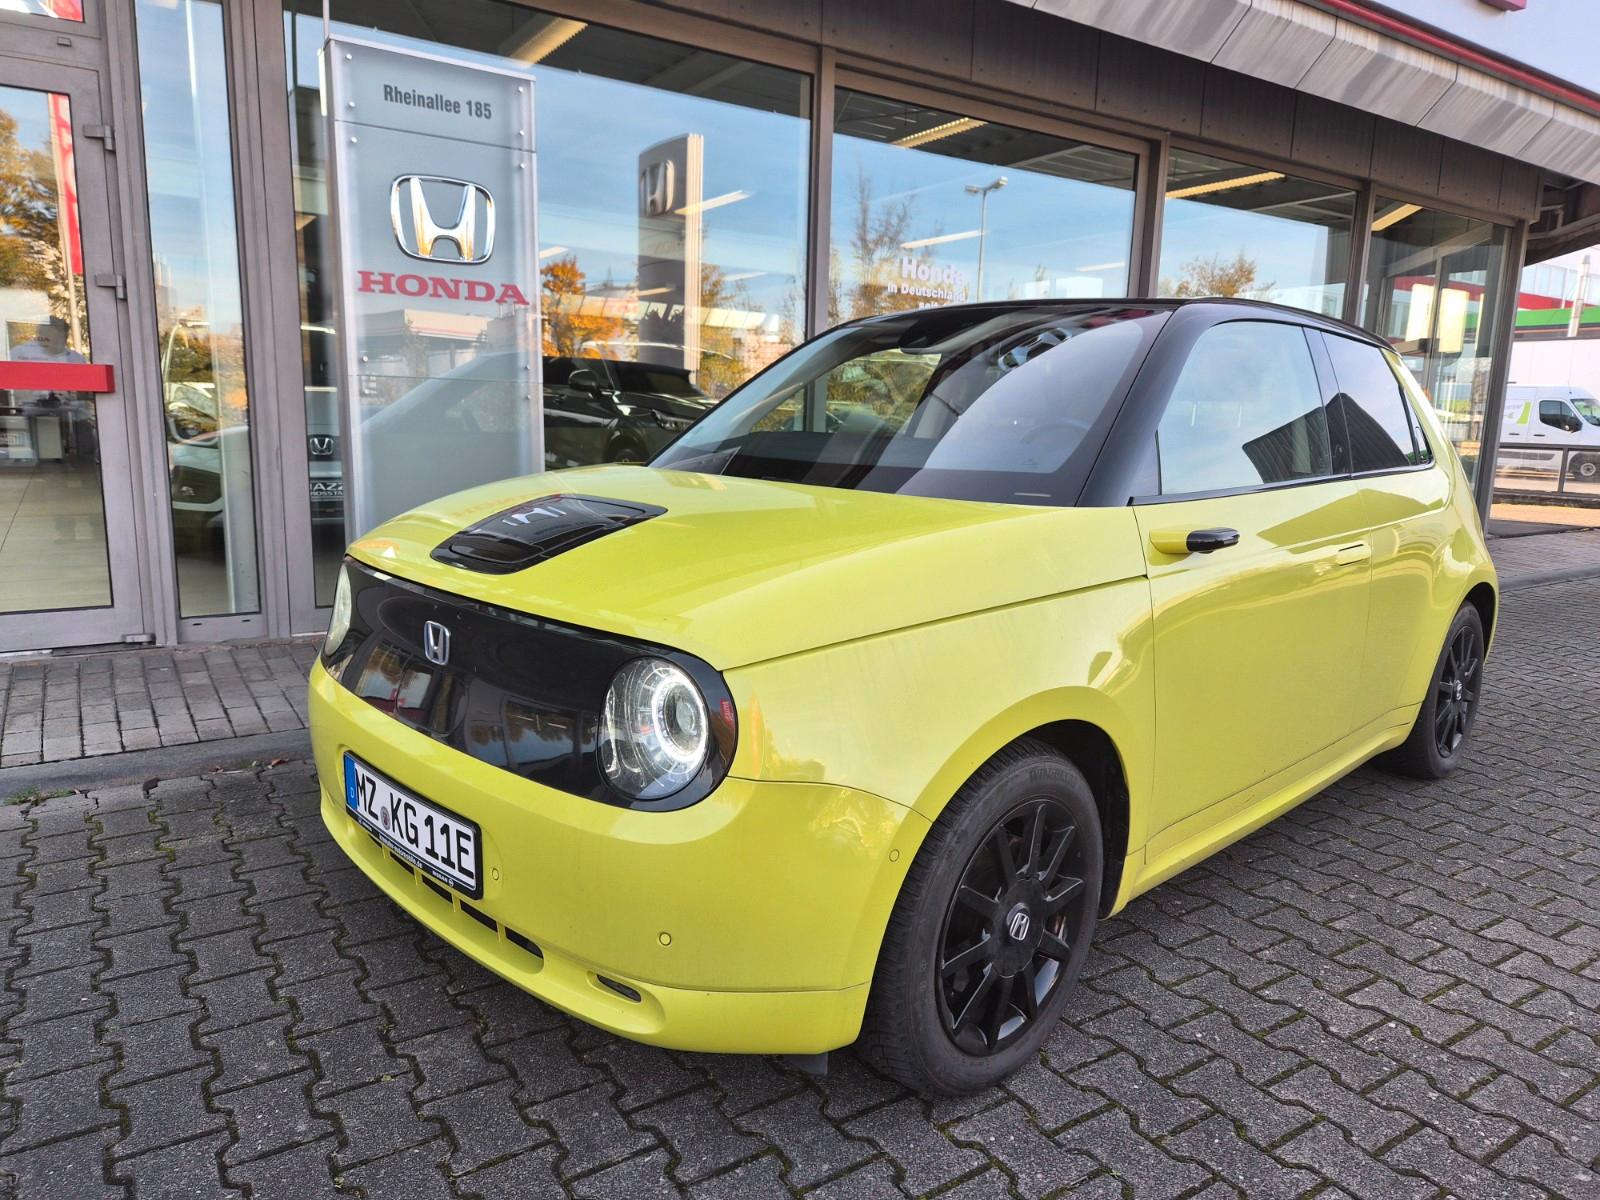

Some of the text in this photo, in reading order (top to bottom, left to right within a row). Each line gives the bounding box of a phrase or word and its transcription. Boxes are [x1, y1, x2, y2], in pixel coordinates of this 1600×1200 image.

[384, 84, 492, 119] Rheinallee 185
[357, 270, 529, 305] HONDA
[901, 283, 966, 303] Deutschland
[355, 768, 475, 880] MZ KG 11E
